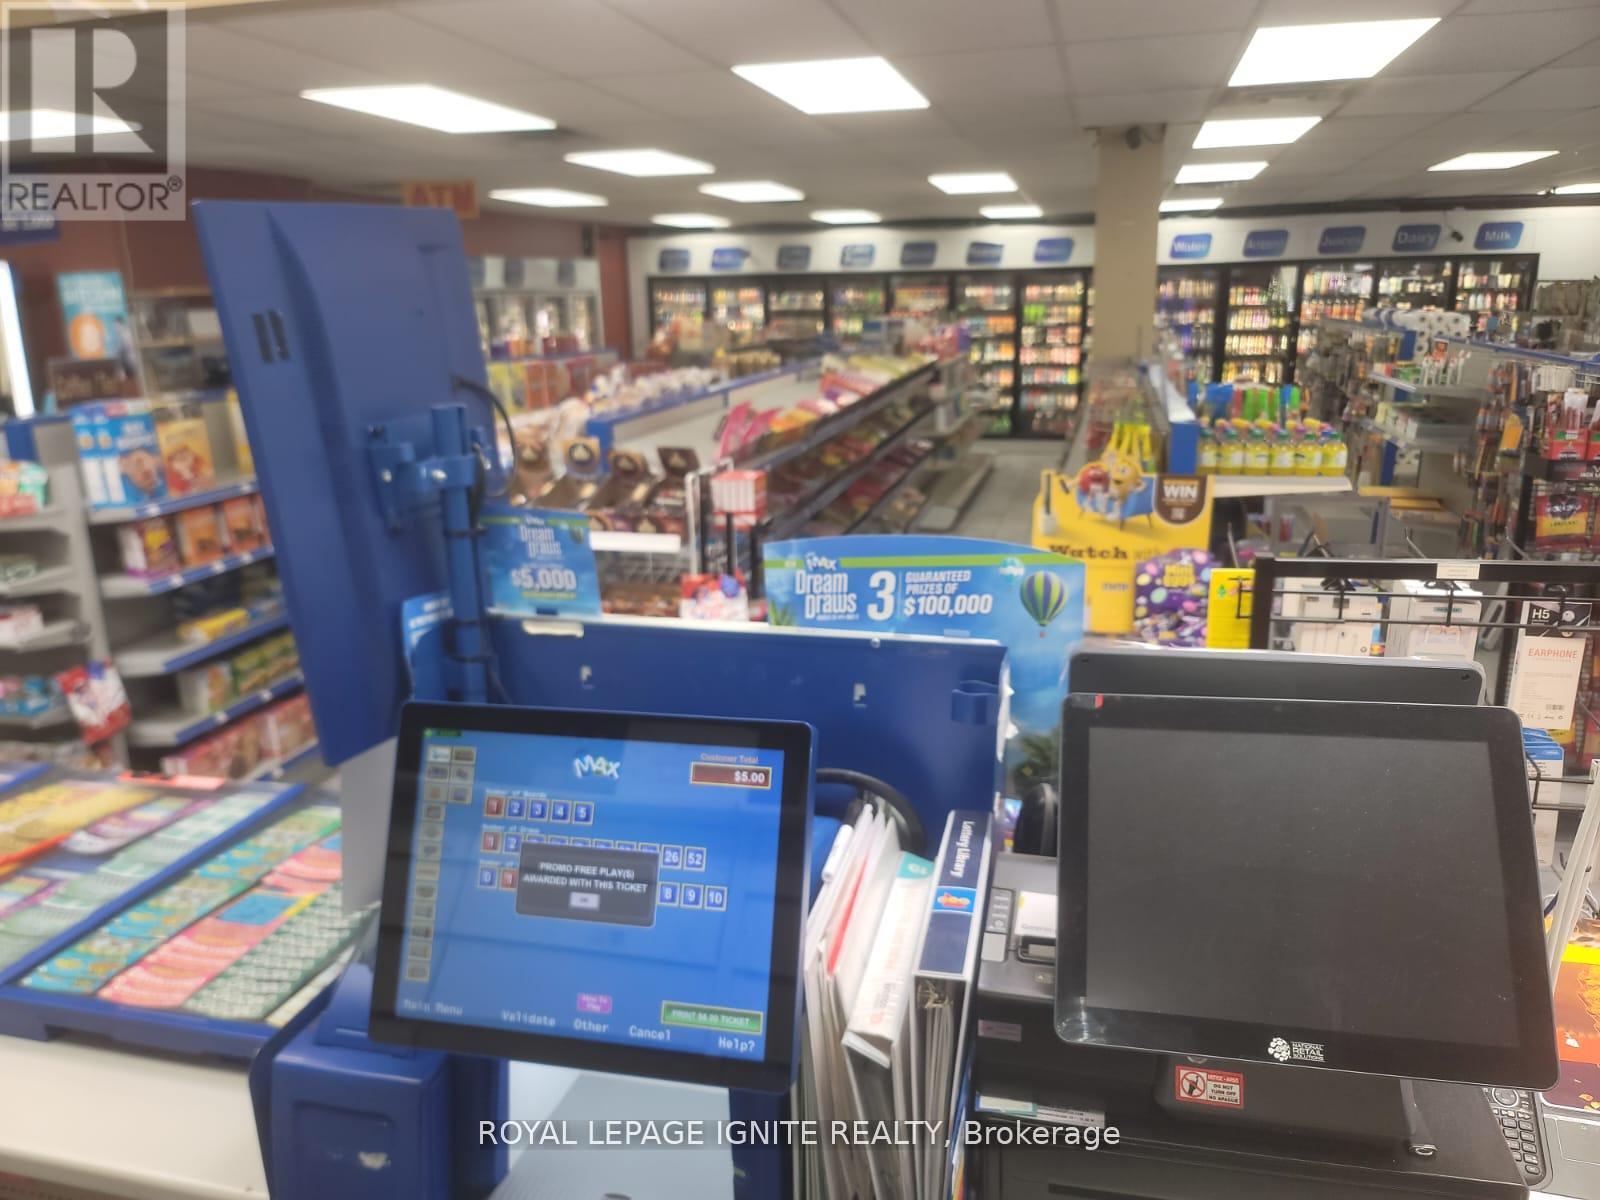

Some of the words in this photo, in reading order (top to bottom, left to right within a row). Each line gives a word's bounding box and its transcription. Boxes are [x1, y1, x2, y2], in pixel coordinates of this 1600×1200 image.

[1397, 230, 1436, 246] Dairy
[1485, 230, 1511, 241] Milk
[1163, 485, 1198, 499] WIN
[520, 525, 555, 542] Dream
[1049, 544, 1128, 559] Watch
[511, 566, 577, 591] $5,000
[795, 569, 848, 595] Dream
[905, 570, 971, 584] GUARANTEED
[867, 570, 897, 620] 3
[905, 583, 943, 595] PRIZES
[944, 582, 959, 594] OF
[805, 593, 857, 619] Draws
[903, 594, 993, 617] $100,000
[1532, 608, 1551, 619] H5
[1528, 647, 1578, 659] EARPHONE
[734, 770, 765, 784] $5.00
[956, 820, 975, 847] Lottery
[664, 850, 679, 864] 26
[687, 853, 703, 866] 52
[950, 848, 971, 878] Library
[539, 862, 573, 874] PROMO
[574, 864, 598, 876] FREE
[599, 866, 635, 879] PLAY(S)
[523, 874, 567, 886] AWARDED
[569, 877, 592, 888] WITH
[594, 880, 614, 891] THIS
[616, 882, 648, 894] TICKET
[663, 886, 673, 900] 8
[687, 889, 697, 902] 9
[708, 891, 723, 905] 10
[403, 999, 431, 1012] Main
[435, 1001, 463, 1016] Menu
[502, 1009, 557, 1027] Validate
[573, 1018, 609, 1033] Other
[721, 1014, 750, 1025] TICKET
[629, 1025, 671, 1041] Cancel
[718, 1036, 756, 1052] Help?
[1292, 1042, 1325, 1050] NATIONAL
[1292, 1047, 1323, 1056] RETAIL
